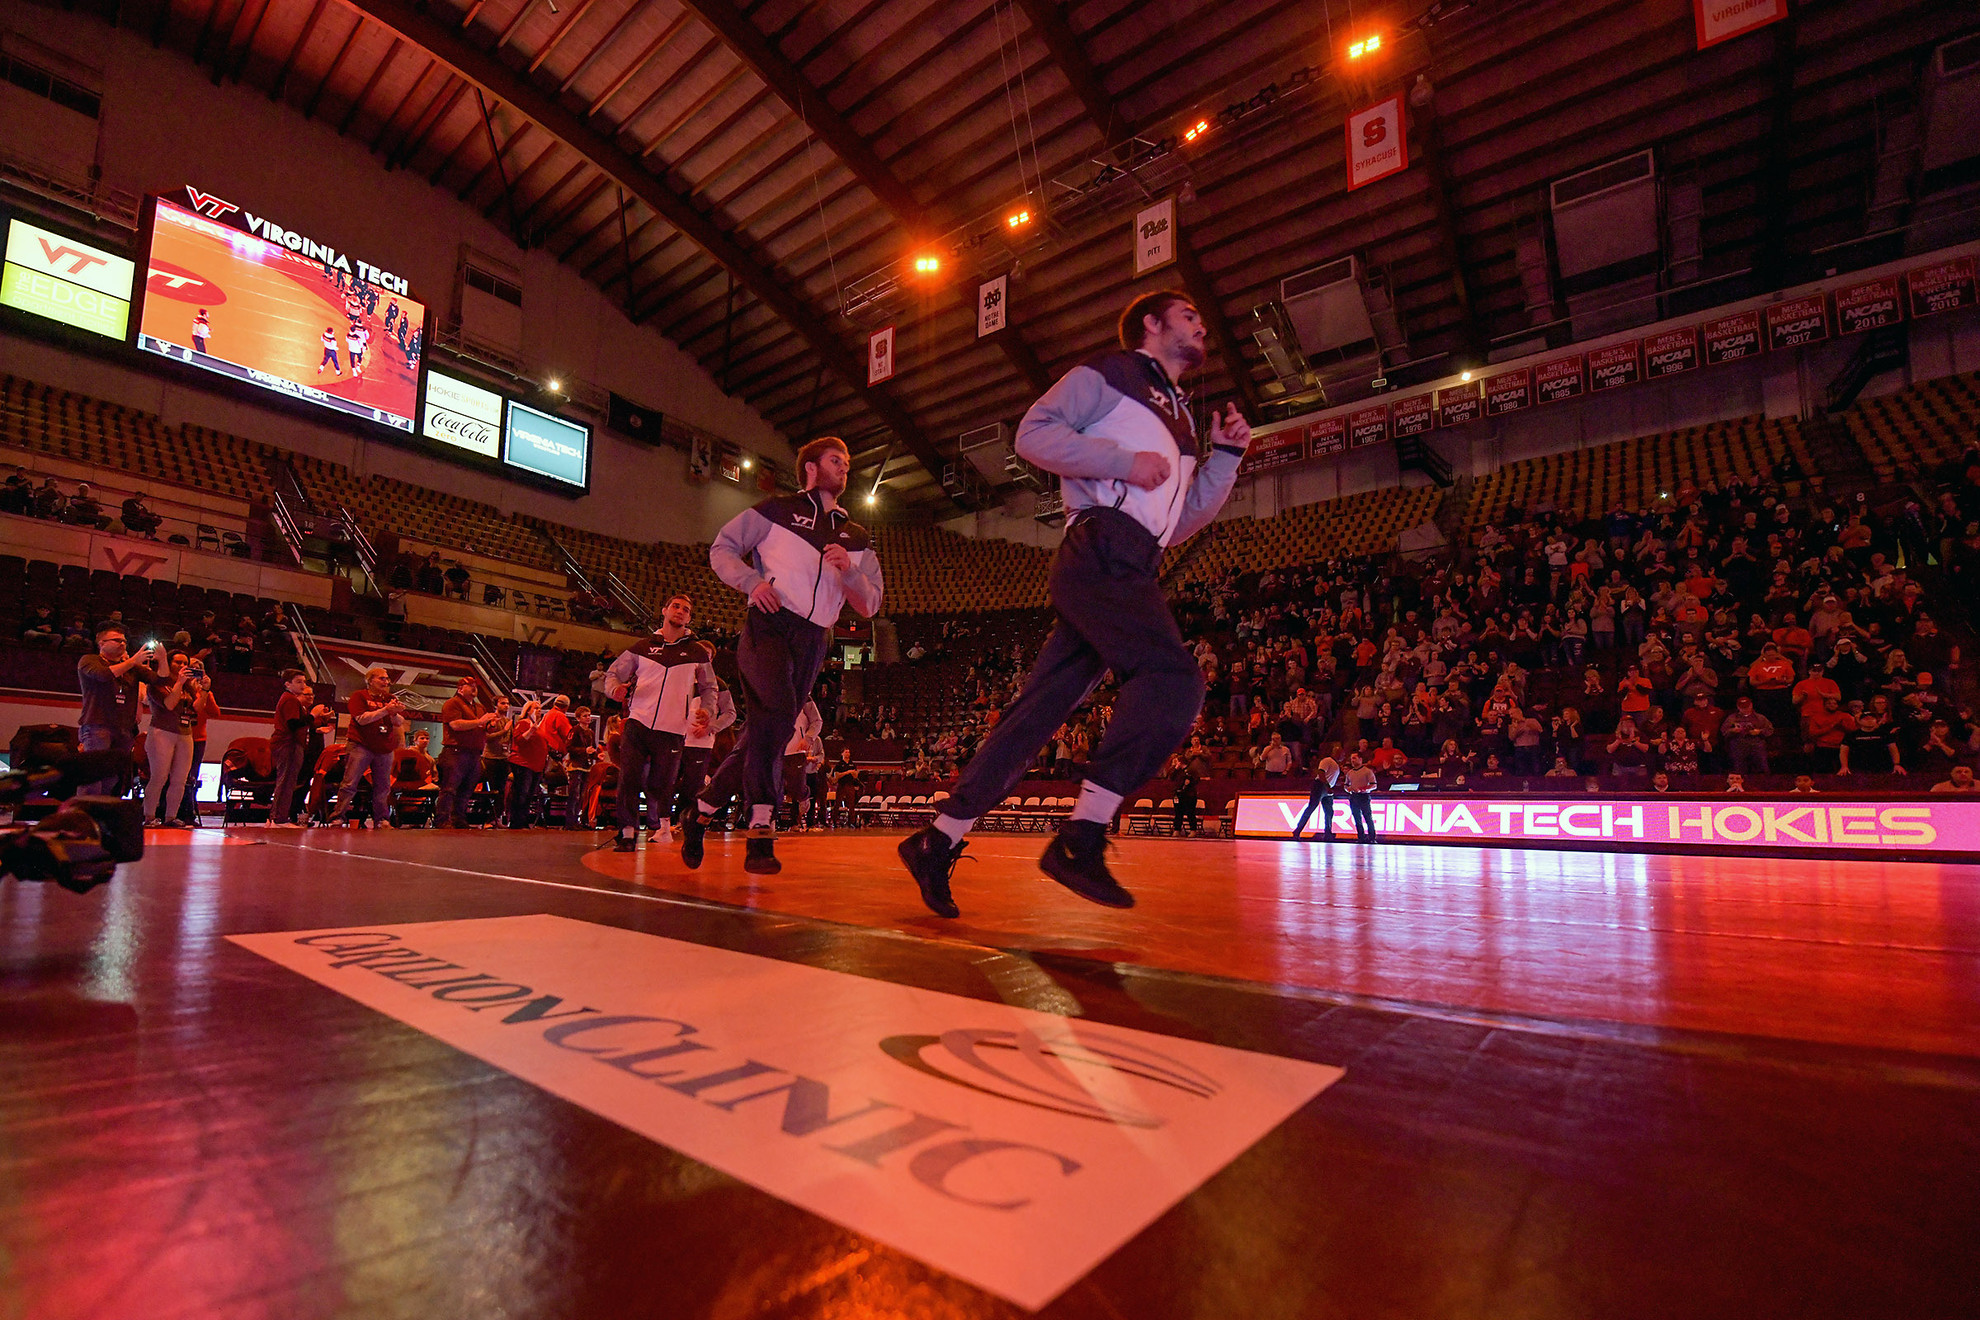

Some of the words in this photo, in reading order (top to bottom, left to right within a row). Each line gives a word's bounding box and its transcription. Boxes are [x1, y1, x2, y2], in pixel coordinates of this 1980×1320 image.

[1354, 147, 1397, 171] SYRACUSE
[1140, 218, 1168, 239] Pitt
[186, 184, 240, 219] VT
[244, 211, 352, 274] VIRGINIA
[356, 259, 409, 296] TECH
[36, 235, 109, 275] VT
[1147, 246, 1160, 257] PITT
[1912, 269, 1970, 289] BASKETBALL
[1925, 265, 1955, 278] MEN'S
[1852, 282, 1881, 296] MEN'S
[1918, 282, 1954, 296] SWEET
[1927, 289, 1961, 303] NCAA
[31, 274, 119, 320] EDGE
[1839, 288, 1895, 307] BASKETBALL
[1931, 297, 1959, 312] 2019
[1770, 305, 1823, 325] BASKETBALL
[1781, 301, 1810, 314] MEN'S
[1845, 300, 1893, 321] NCAA
[984, 311, 999, 321] NOTRE
[985, 318, 998, 329] DAME
[1717, 317, 1744, 329] MEN'S
[1707, 321, 1758, 339] BASKETBALL
[1775, 317, 1821, 337] NCAA
[1657, 333, 1682, 345] MEN'S
[1712, 333, 1755, 352] NCAA
[1785, 332, 1811, 345] 2017
[1601, 347, 1625, 358] MEN'S
[1647, 338, 1694, 355] BASKETBALL
[1721, 347, 1746, 360] 2007
[1591, 352, 1635, 368] BASKETBALL
[1651, 348, 1692, 367] NCAA
[1537, 366, 1580, 380] BASKETBALL
[1547, 361, 1570, 371] MEN'S
[1595, 362, 1634, 379] NCAA
[247, 368, 298, 393] VIRGINIA
[1487, 379, 1526, 393] BASKETBALL
[1496, 374, 1518, 385] MEN'S
[1541, 375, 1578, 392] NCAA
[1440, 392, 1479, 405] BASKETBALL
[1448, 386, 1469, 397] MEN'S
[1491, 388, 1525, 405] NCAA
[1394, 403, 1430, 416] BASKETBALL
[1403, 398, 1422, 408] MEN'S
[1444, 400, 1477, 416] NCAA
[387, 414, 408, 428] VT
[1353, 414, 1385, 426] BASKETBALL
[1359, 410, 1377, 418] MEN'S
[1398, 412, 1429, 427] NCAA
[1451, 412, 1470, 423] 1979
[430, 411, 492, 444] Coca-Cola
[1312, 425, 1343, 437] BASKETBALL
[1354, 423, 1383, 438] NCAA
[512, 427, 556, 450] VIRGINIA
[792, 513, 813, 525] VT
[103, 547, 168, 576] VT
[521, 623, 557, 646] VT
[1487, 804, 1644, 838] TECH
[1668, 806, 1937, 845] HOKIES
